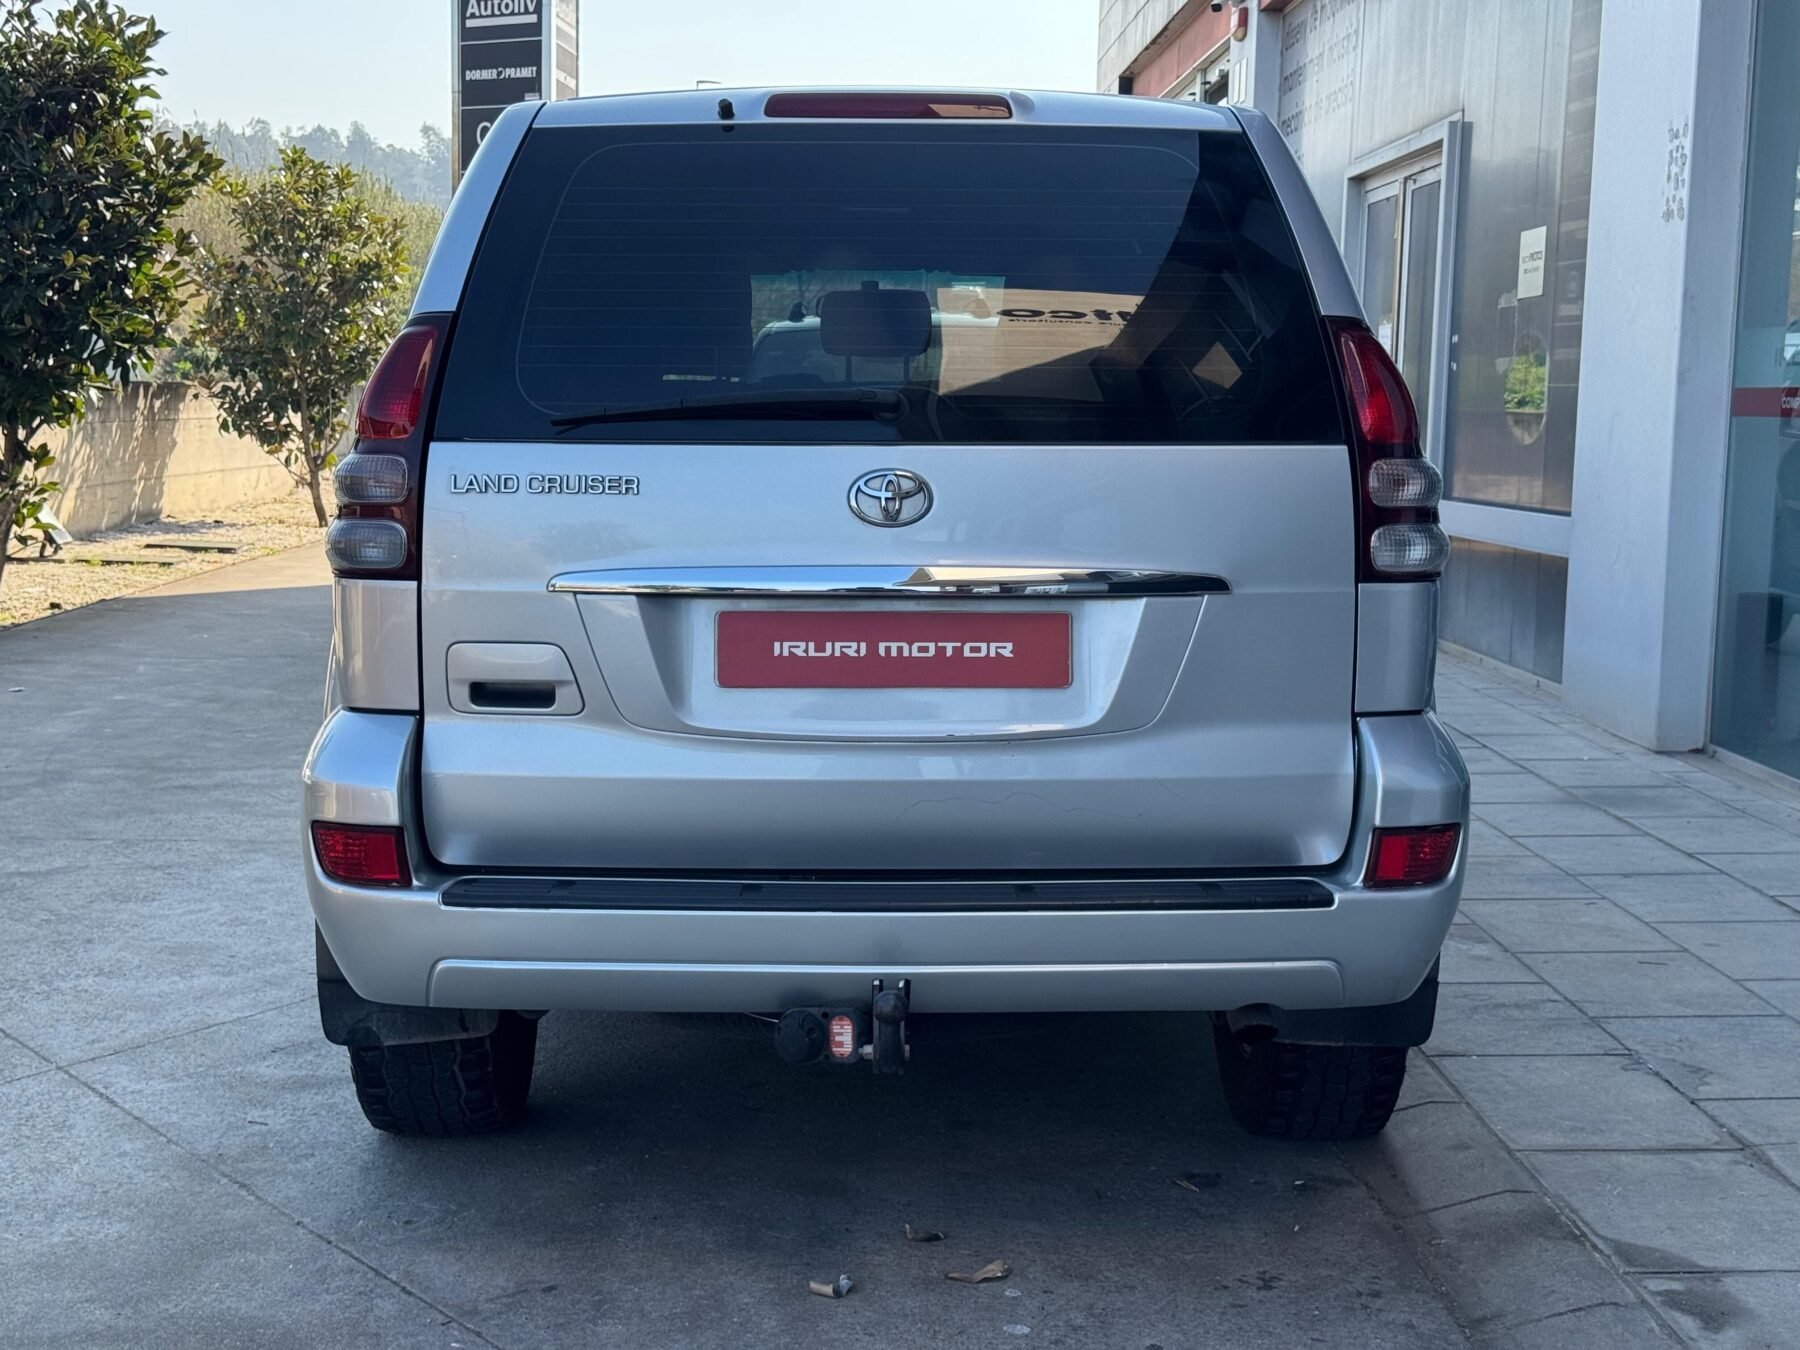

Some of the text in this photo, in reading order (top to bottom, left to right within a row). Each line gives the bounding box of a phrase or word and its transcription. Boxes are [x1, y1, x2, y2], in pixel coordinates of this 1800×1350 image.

[466, 0, 537, 17] Autoliv
[465, 66, 537, 80] DORMER PRAMET
[450, 474, 640, 495] LAND CRUISER
[774, 641, 1014, 657] IRURI MOTOR
